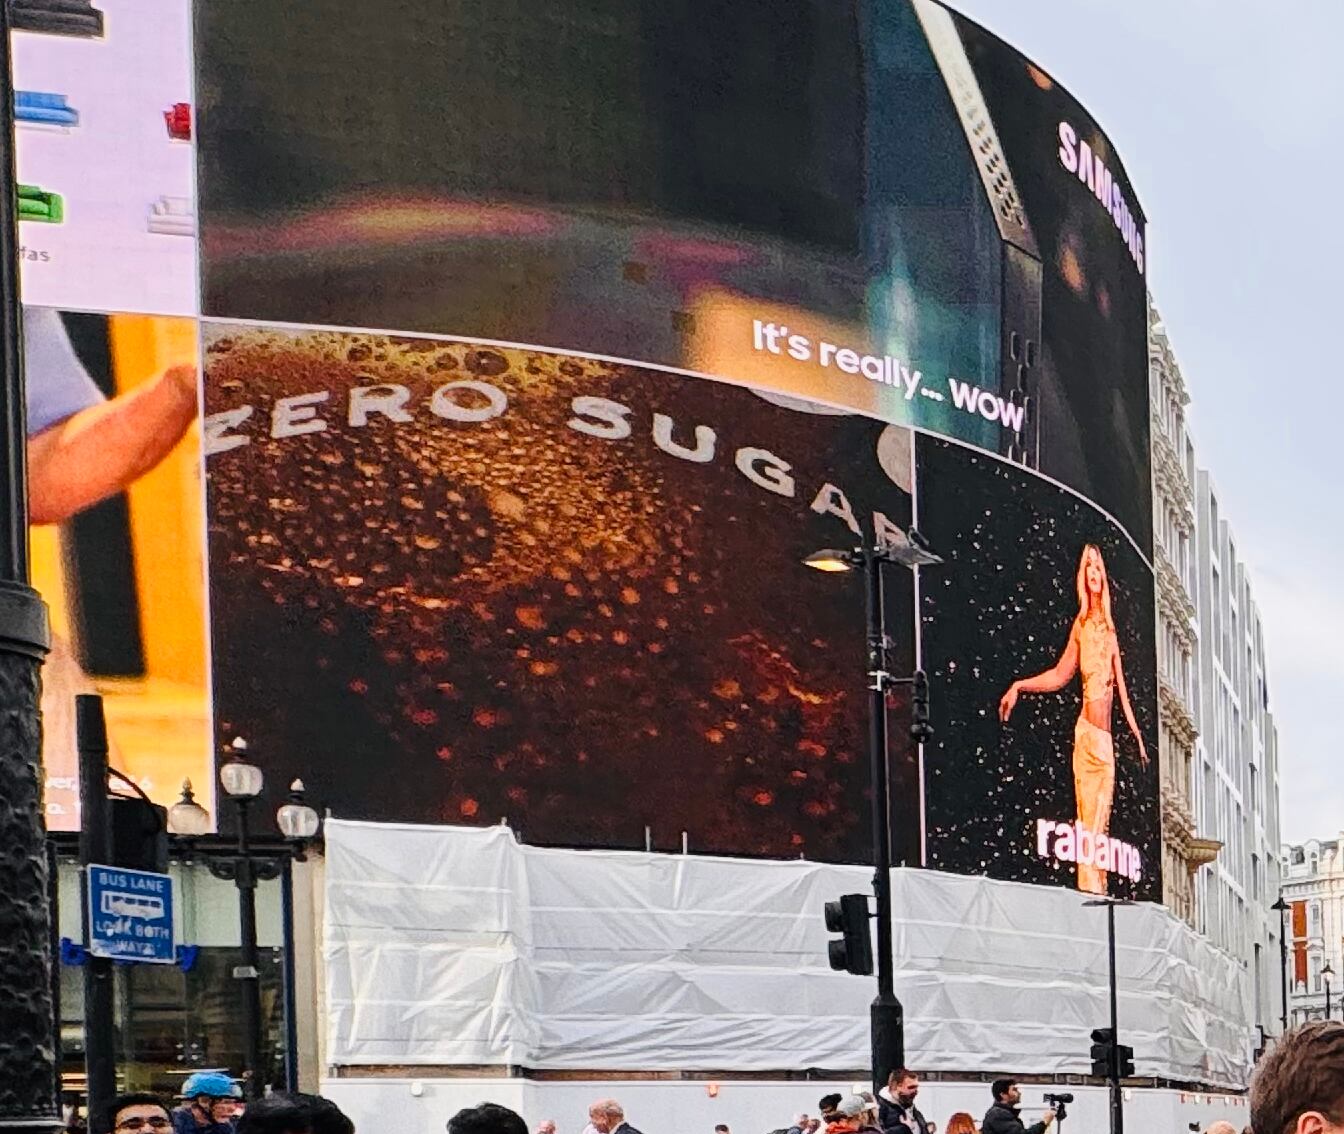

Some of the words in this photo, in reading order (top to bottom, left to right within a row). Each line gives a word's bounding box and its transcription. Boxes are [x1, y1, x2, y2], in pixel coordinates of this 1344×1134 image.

[1058, 121, 1144, 275] SAMSUNG
[752, 320, 810, 361] It's
[819, 341, 944, 401] really...
[949, 377, 1025, 432] wow
[201, 380, 508, 456] ZERO
[98, 872, 127, 888] BUS
[131, 877, 164, 893] LANE
[1036, 818, 1141, 883] rabanne
[135, 924, 170, 939] BOTH
